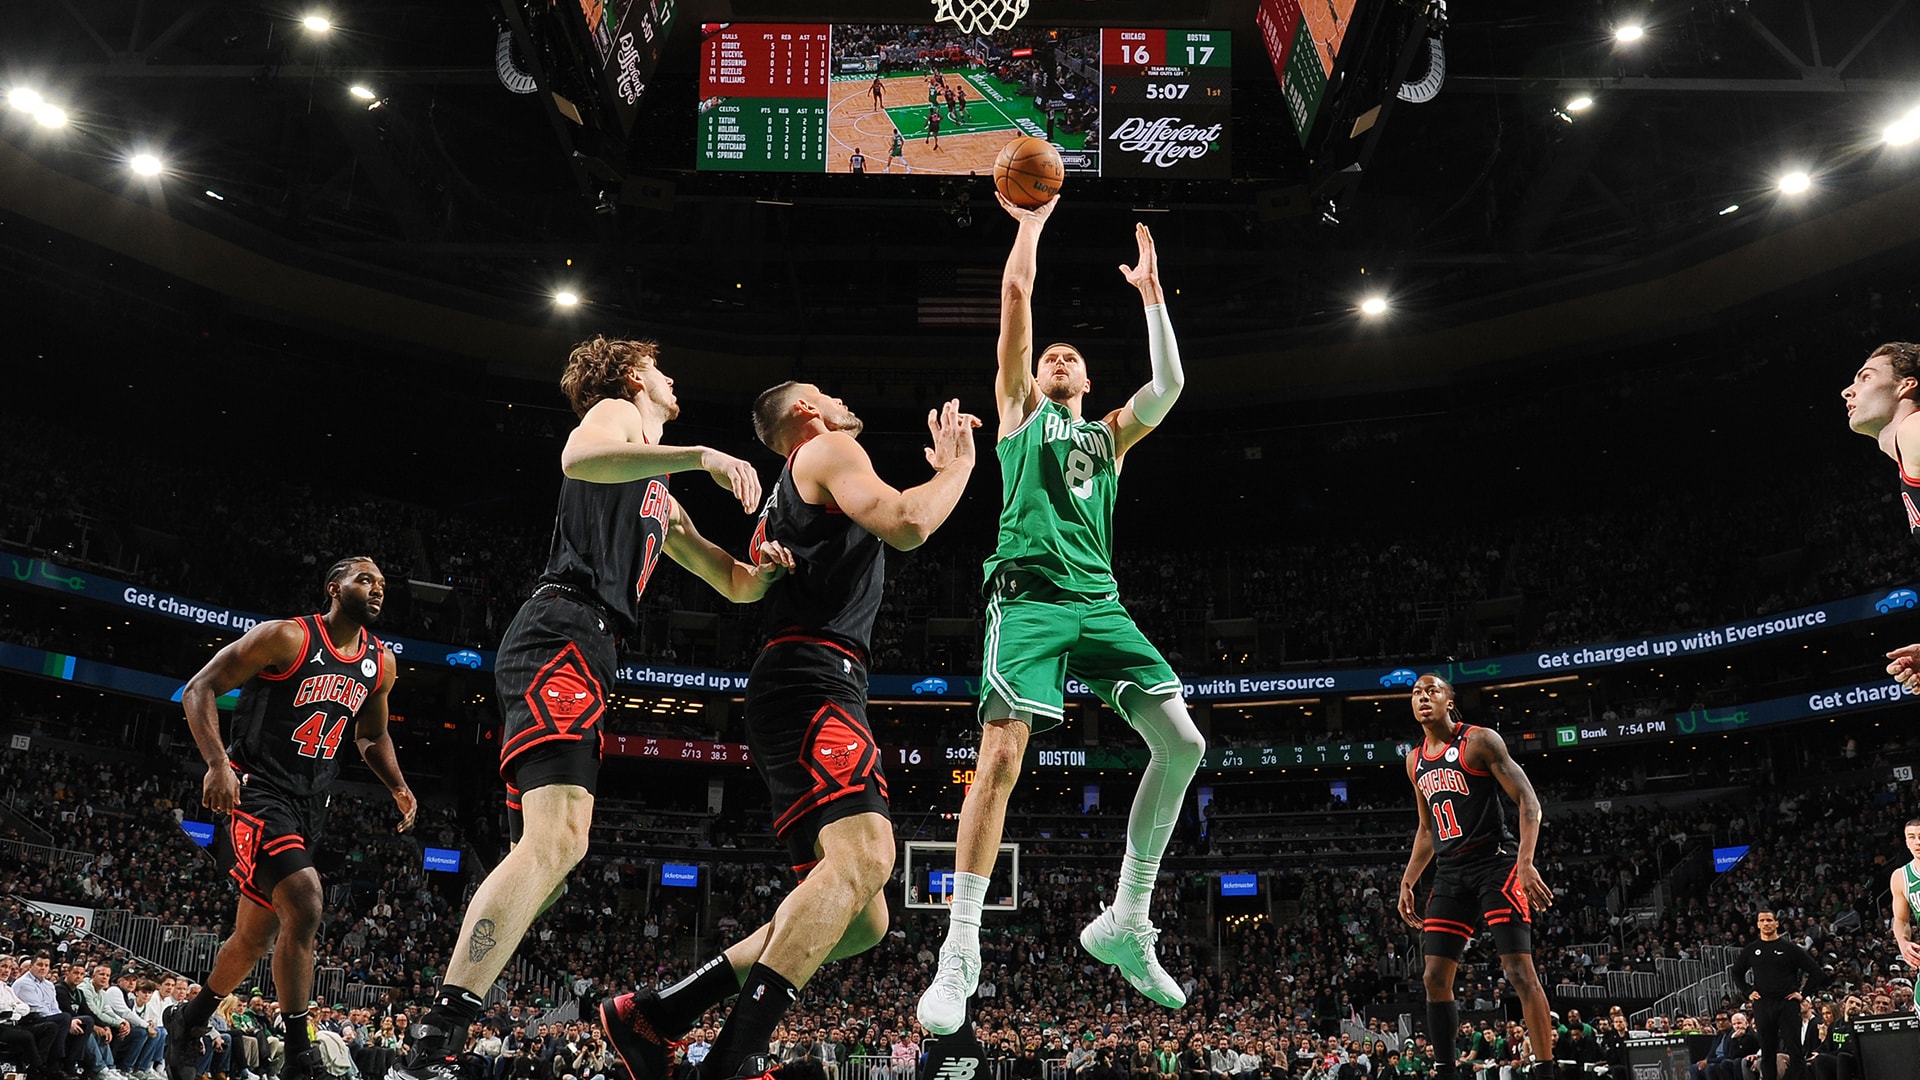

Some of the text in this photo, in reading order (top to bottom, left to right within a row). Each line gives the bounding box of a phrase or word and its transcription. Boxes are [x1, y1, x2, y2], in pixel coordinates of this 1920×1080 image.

[1121, 46, 1215, 64] 16 17
[1110, 84, 1221, 99] 7 5:07 1st
[1109, 117, 1222, 152] Different
[1141, 141, 1208, 168] Here
[1066, 449, 1094, 500] 8
[123, 587, 258, 632] Get charged up
[1538, 610, 1826, 669] Get charged up with Eversource
[615, 667, 633, 680] et
[636, 669, 705, 687] charged
[709, 676, 730, 690] up
[1066, 680, 1094, 695] Ge
[1198, 680, 1236, 694] with
[1240, 676, 1335, 693] Eversource
[1809, 680, 1914, 711] Get charge
[291, 711, 348, 760] 44
[1558, 721, 1666, 742] TD Bank 7:54 PM
[16, 737, 28, 748] 15
[643, 747, 659, 756] 2/6
[681, 749, 702, 758] 5/13
[710, 751, 727, 760] 38.5
[742, 752, 748, 760] 6
[898, 749, 922, 765] 16
[1039, 750, 1086, 766] BOSTON
[1222, 757, 1243, 767] 6/13
[1261, 755, 1277, 765] 3/8
[1296, 754, 1303, 763] 3
[1343, 752, 1350, 761] 6
[1367, 751, 1374, 760] 8
[952, 770, 977, 784] 5:0
[1896, 768, 1909, 779] 19
[1432, 799, 1463, 841] 11
